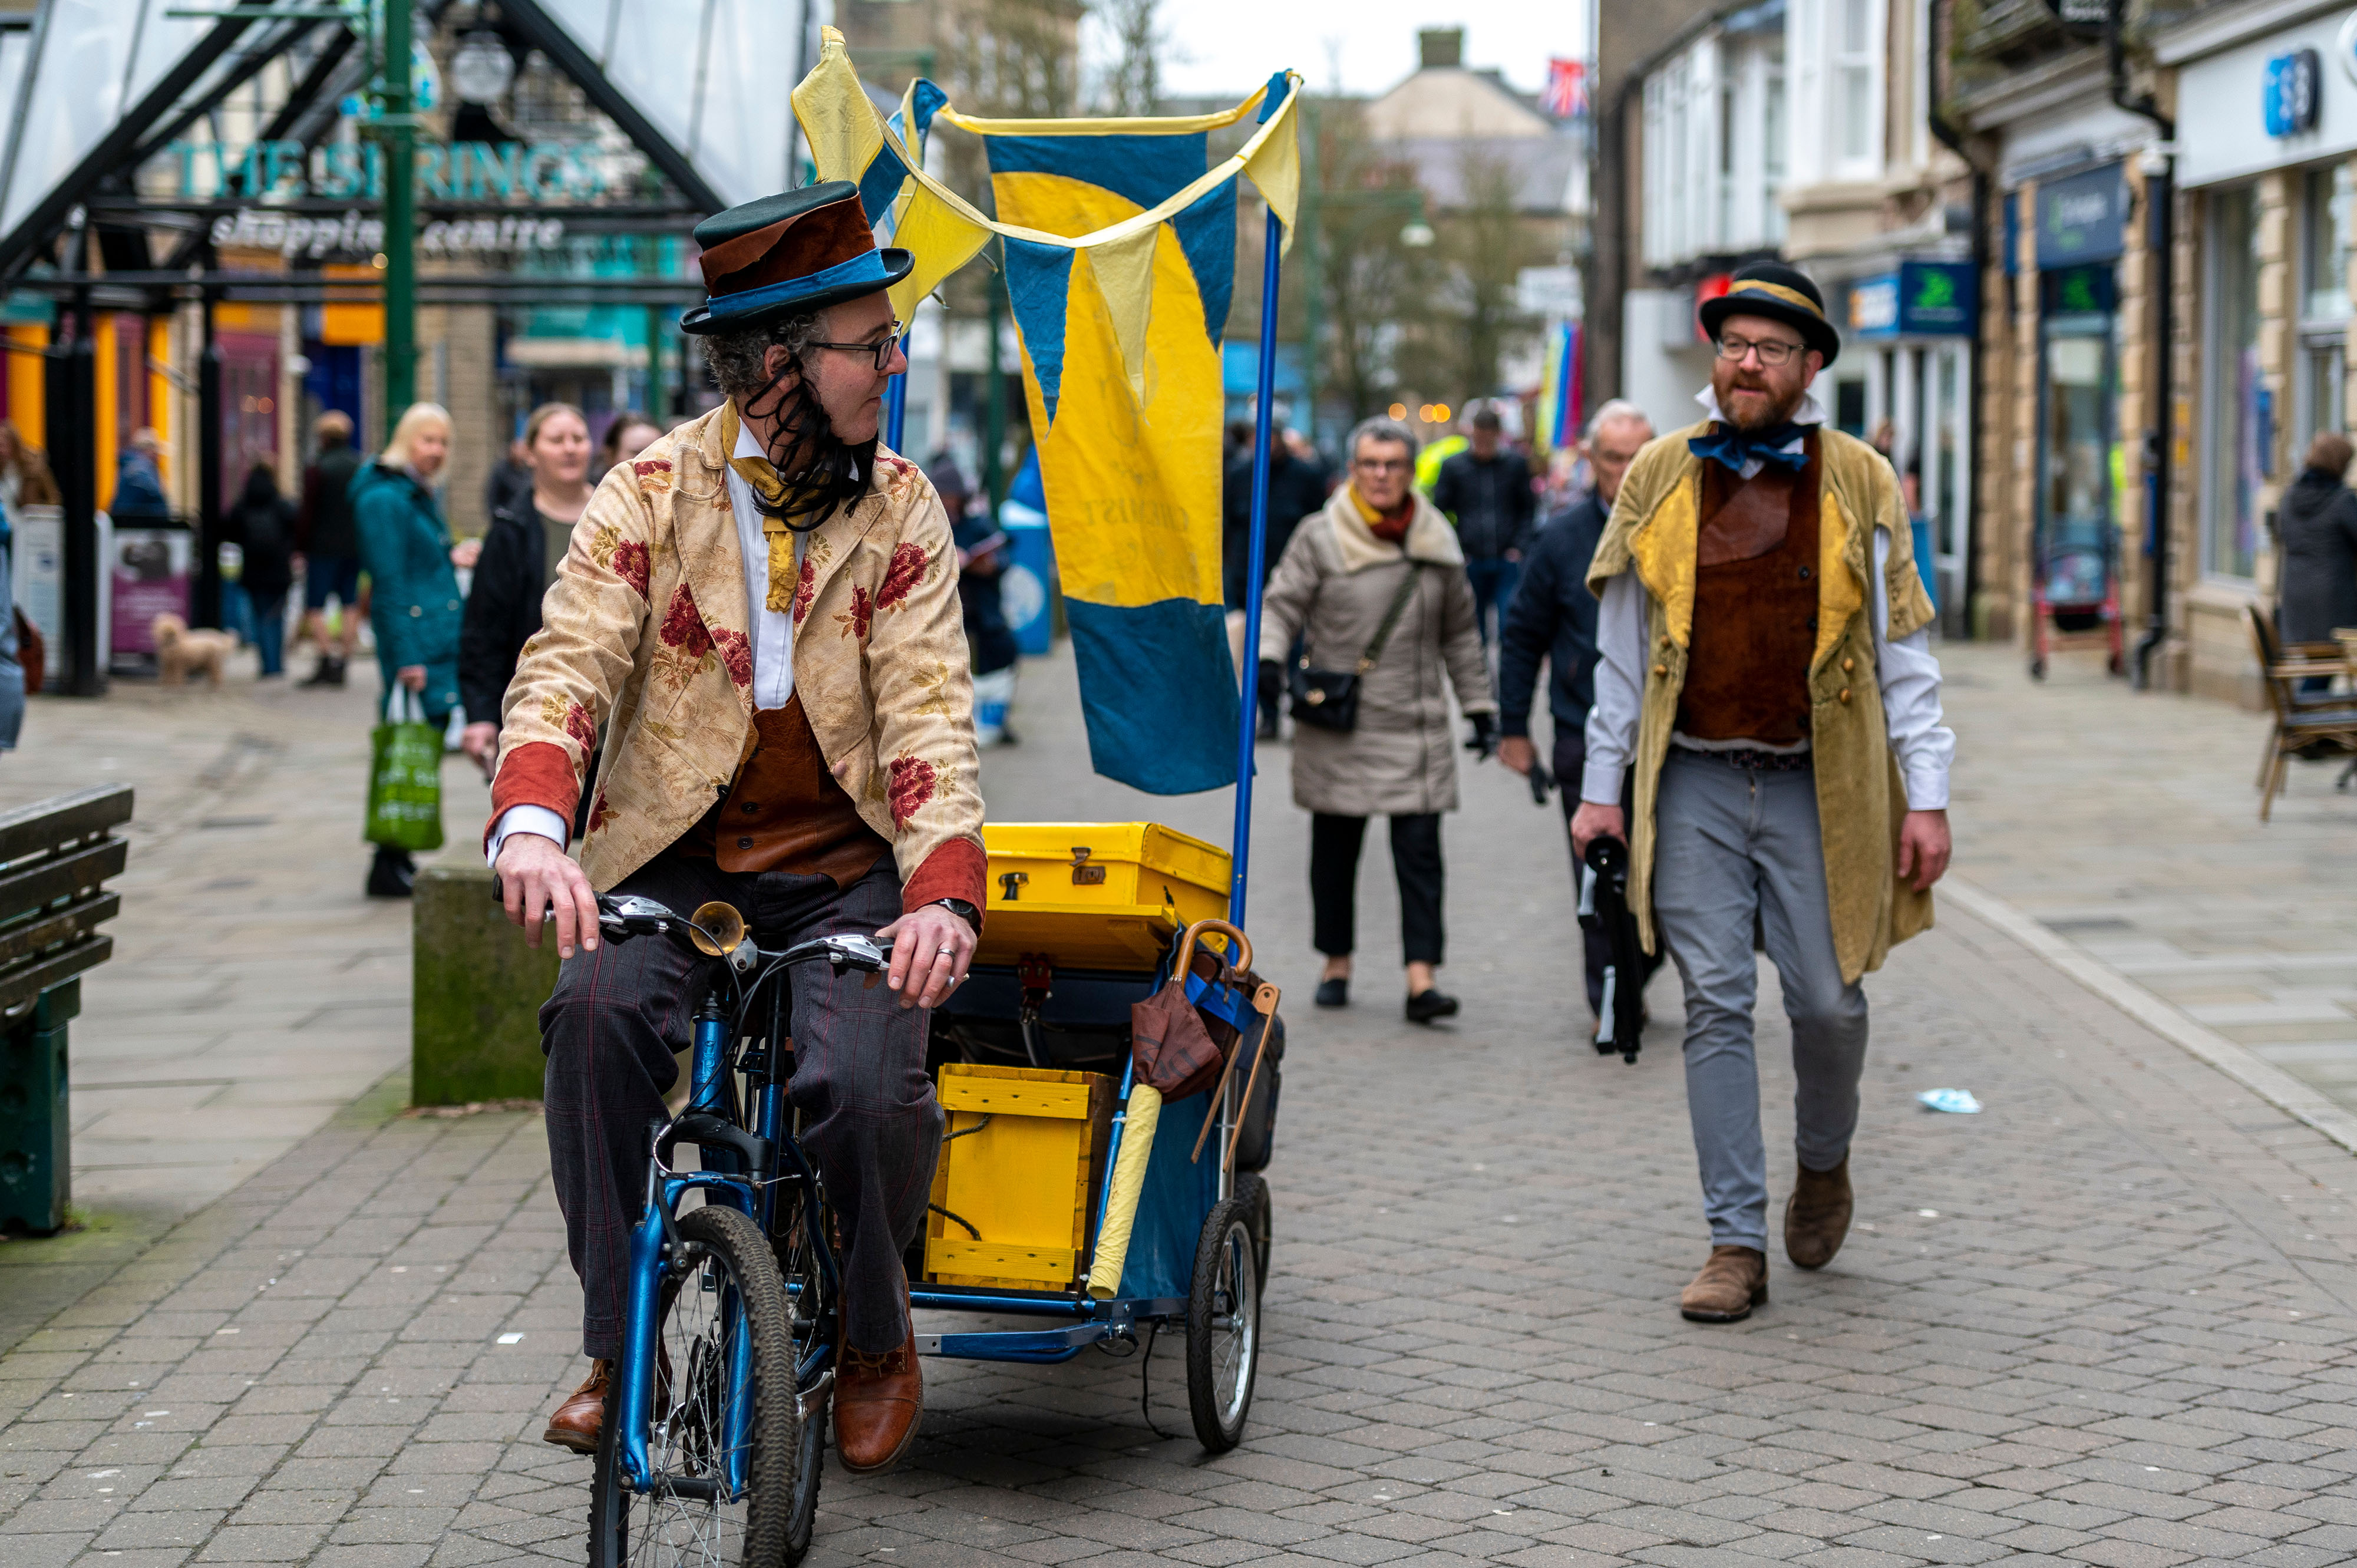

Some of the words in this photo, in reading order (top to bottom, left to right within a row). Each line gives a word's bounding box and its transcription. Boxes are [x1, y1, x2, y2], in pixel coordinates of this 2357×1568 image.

[167, 139, 306, 198] THE
[209, 206, 386, 259] shoppin
[422, 215, 564, 252] centre
